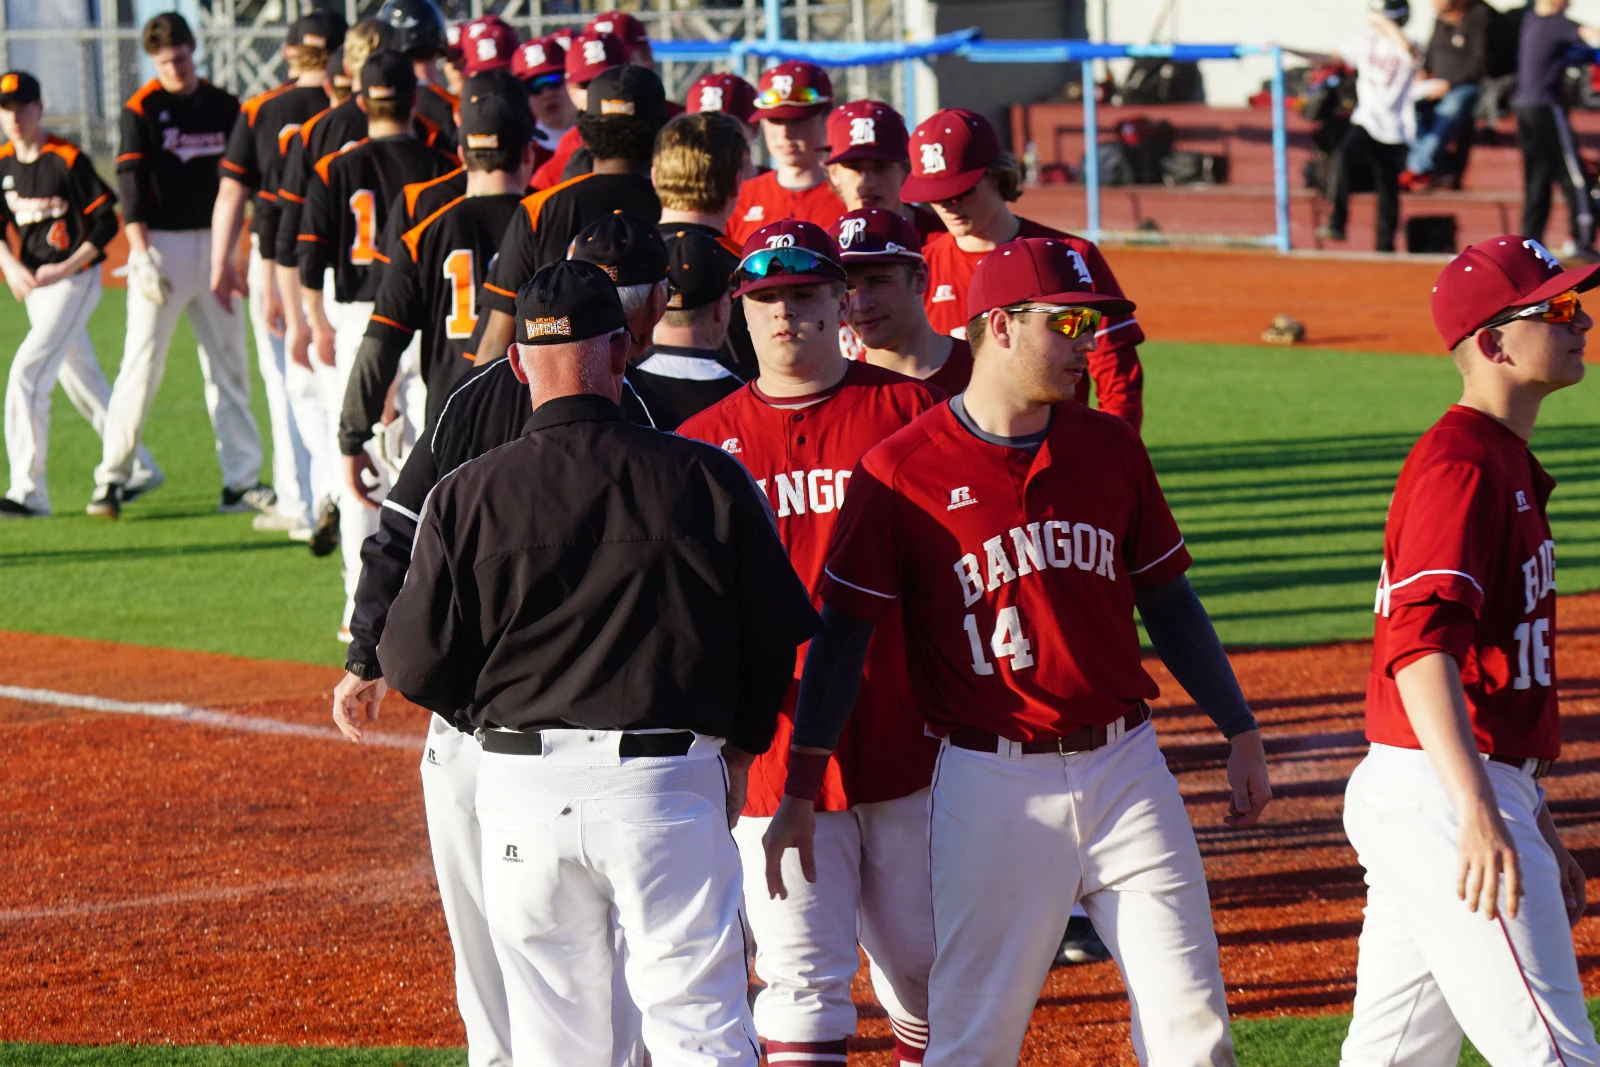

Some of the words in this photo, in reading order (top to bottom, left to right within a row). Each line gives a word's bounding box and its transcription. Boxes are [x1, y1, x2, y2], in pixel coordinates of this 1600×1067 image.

[350, 189, 375, 265] 1
[525, 316, 572, 340] WITCHES
[756, 468, 853, 518] NGO
[953, 520, 1116, 608] BANGOR
[963, 605, 1035, 676] 14
[505, 844, 518, 857] R
